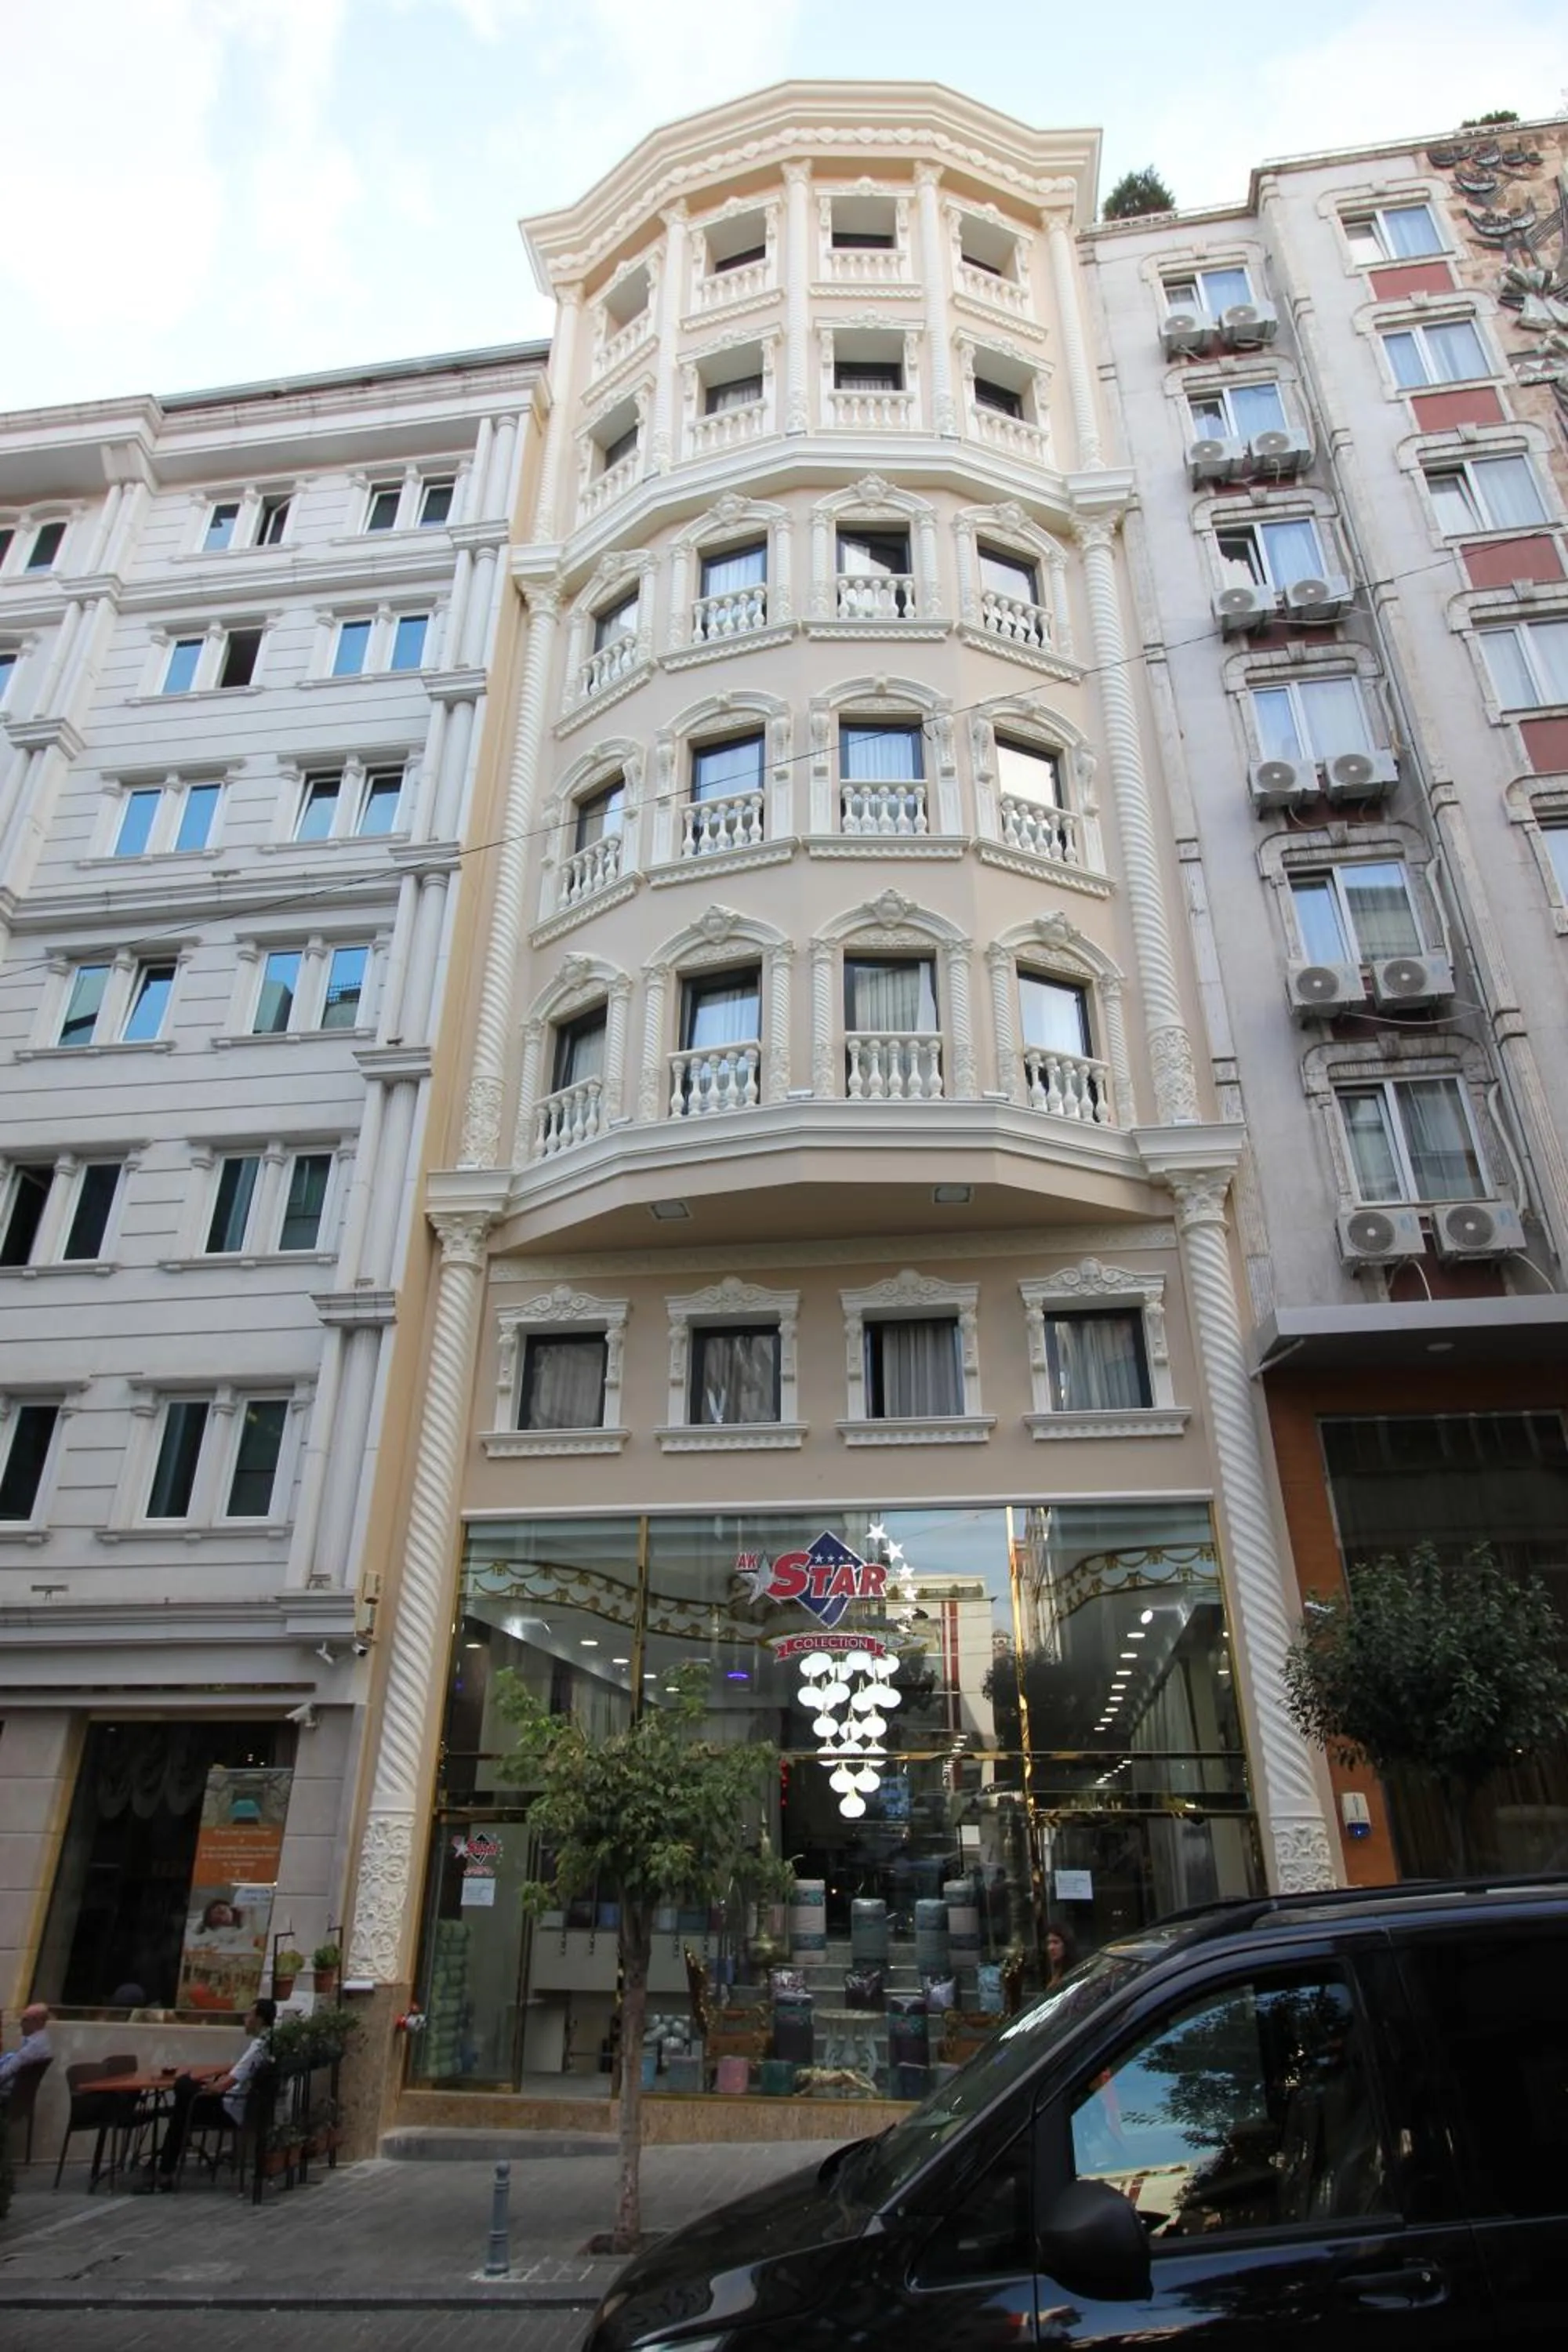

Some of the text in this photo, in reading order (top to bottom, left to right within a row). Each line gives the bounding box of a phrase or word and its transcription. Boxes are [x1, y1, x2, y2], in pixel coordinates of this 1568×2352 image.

[736, 1551, 887, 1599] AK STAR
[793, 1637, 869, 1650] COLECTION
